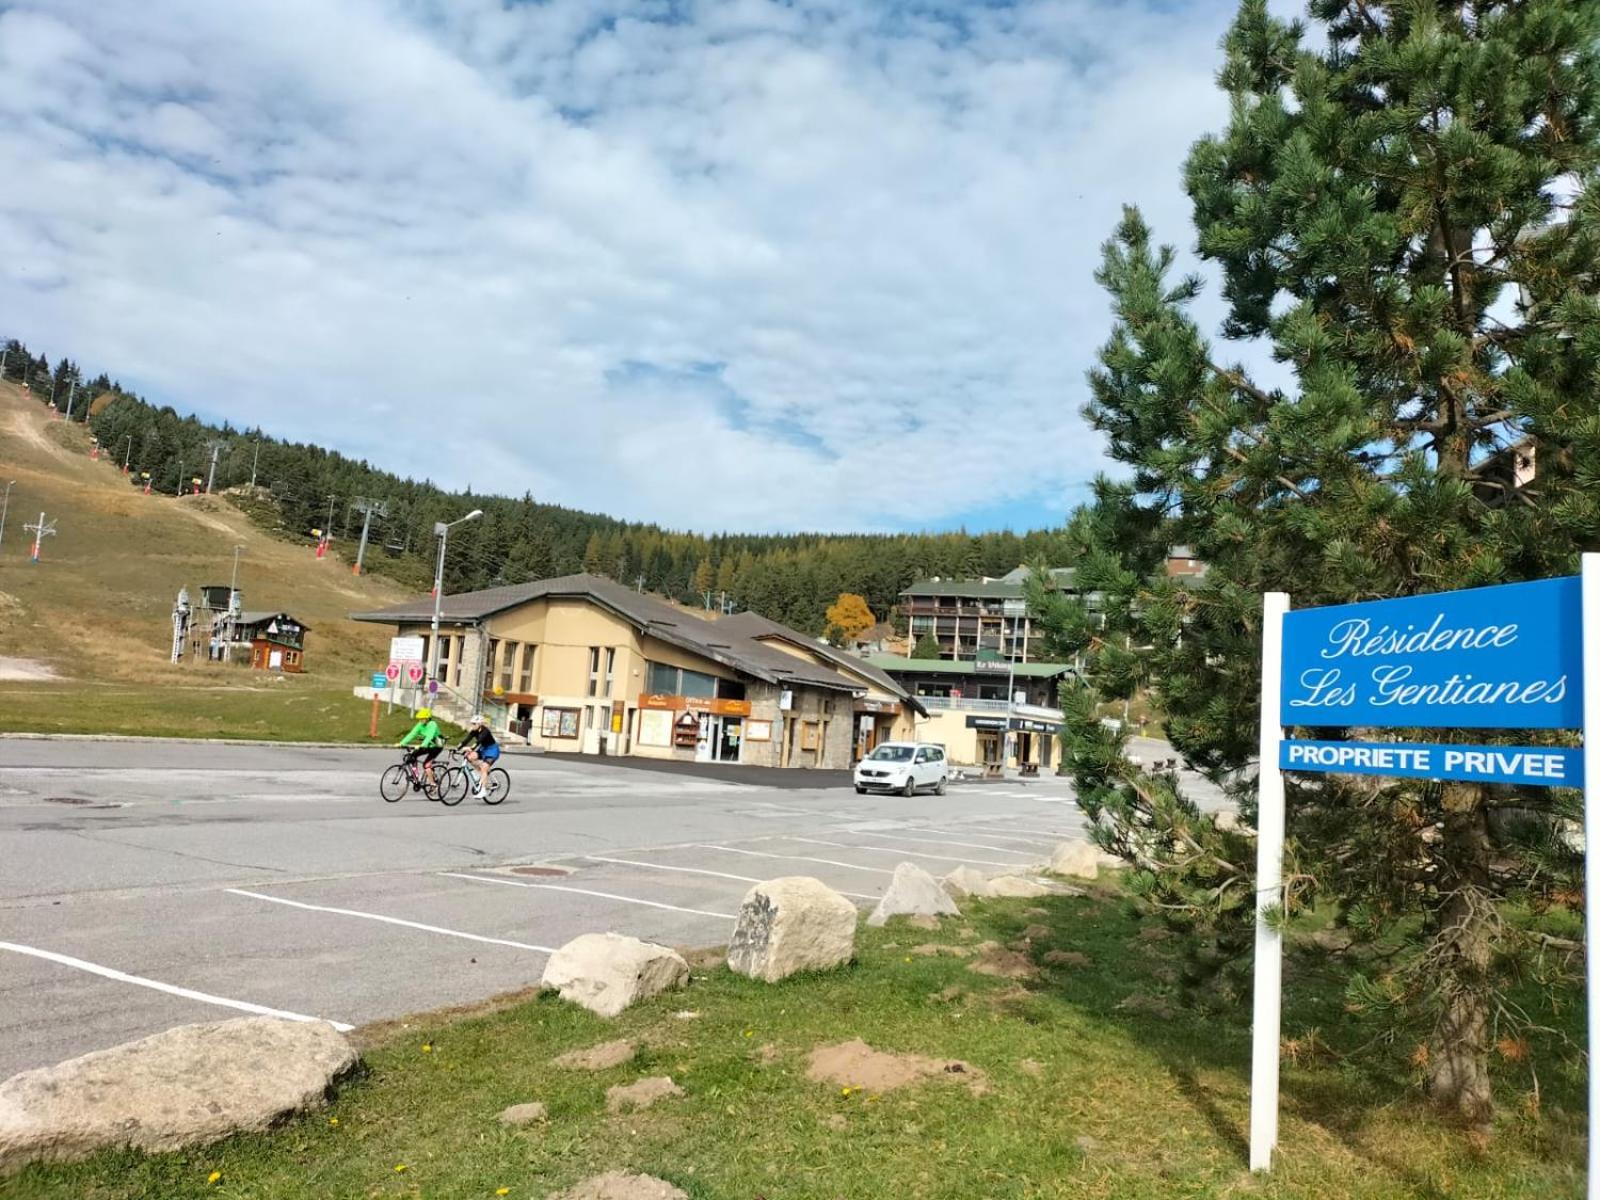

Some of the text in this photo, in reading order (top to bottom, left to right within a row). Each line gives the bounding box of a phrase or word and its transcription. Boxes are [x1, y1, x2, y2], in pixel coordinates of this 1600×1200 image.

[1320, 613, 1519, 659] Résidence
[1289, 665, 1568, 708] Les Gentianes
[1289, 744, 1566, 778] PROPRIETE PRIVEE
